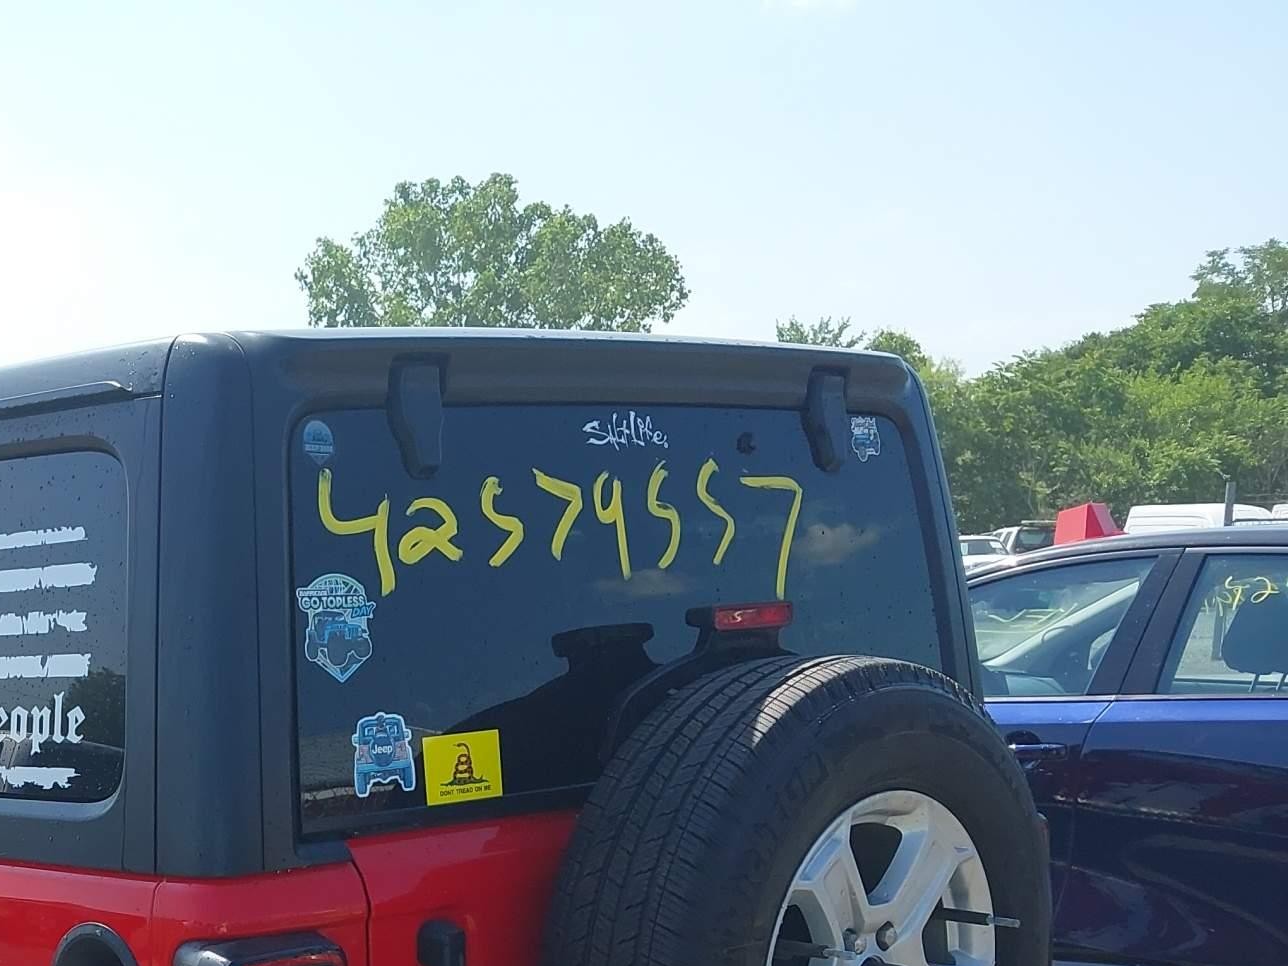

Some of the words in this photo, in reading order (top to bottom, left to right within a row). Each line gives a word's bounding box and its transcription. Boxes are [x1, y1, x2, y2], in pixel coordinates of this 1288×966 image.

[318, 458, 803, 600] 42579557
[302, 598, 320, 608] GO
[322, 596, 364, 609] TOPLESS
[352, 606, 372, 617] DAY
[372, 744, 393, 755] Jeep
